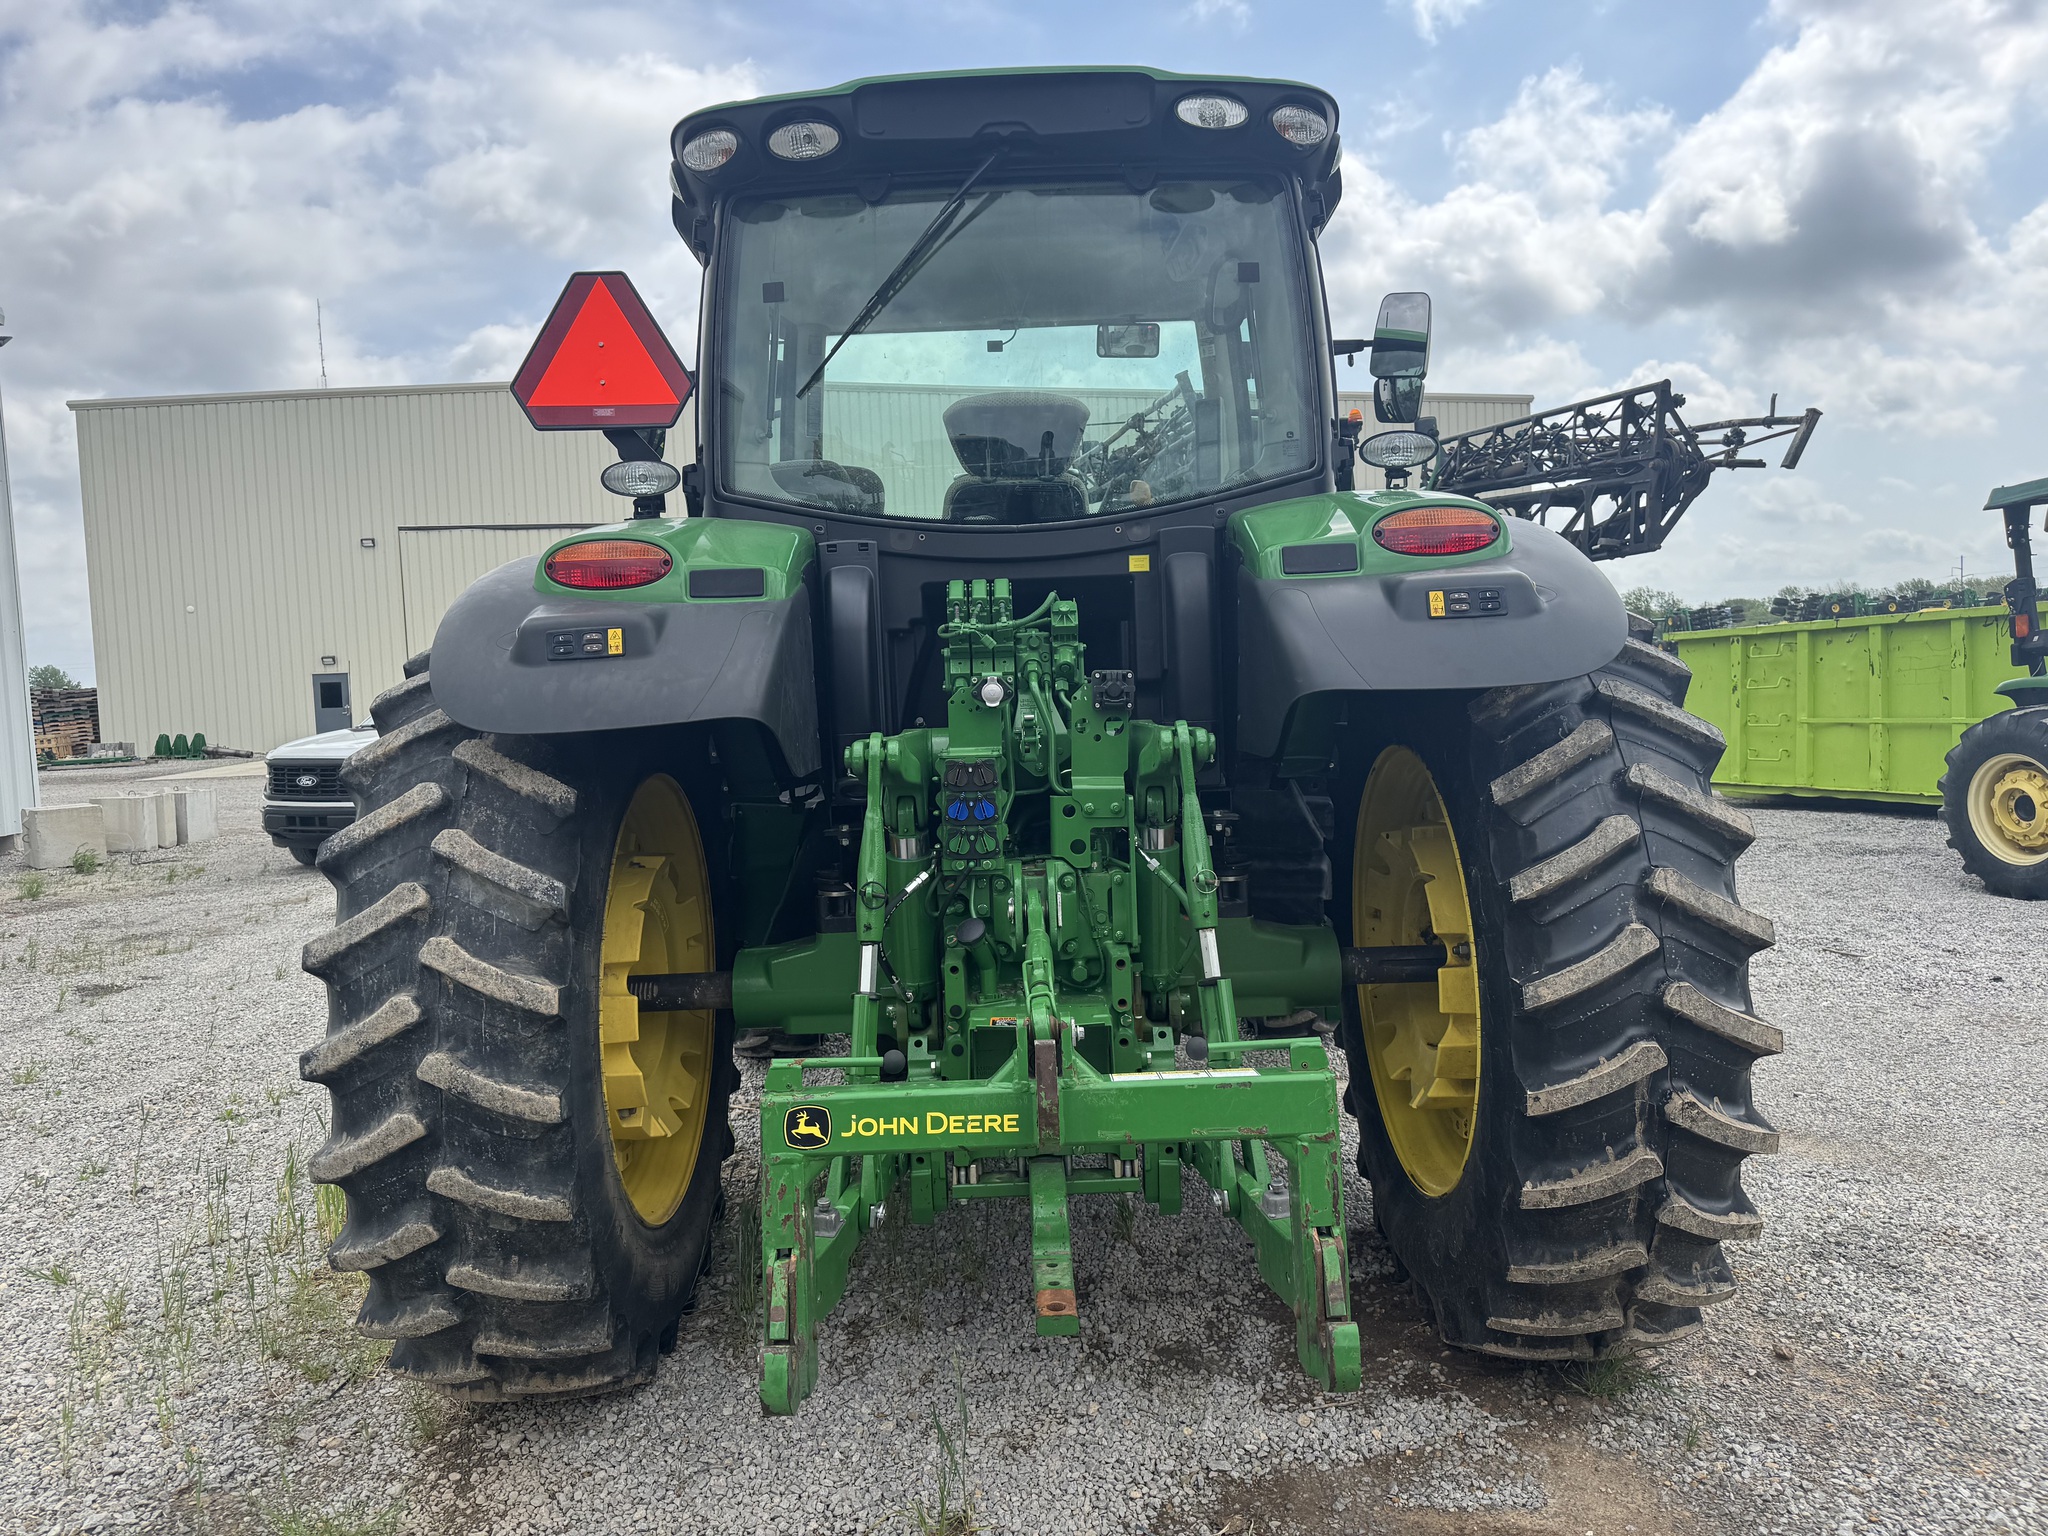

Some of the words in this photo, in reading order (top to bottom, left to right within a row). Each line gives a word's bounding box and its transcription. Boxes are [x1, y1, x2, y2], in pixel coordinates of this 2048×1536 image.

[299, 776, 314, 786] Ford
[841, 1114, 918, 1137] JOHN
[926, 1112, 1020, 1134] DEERE
